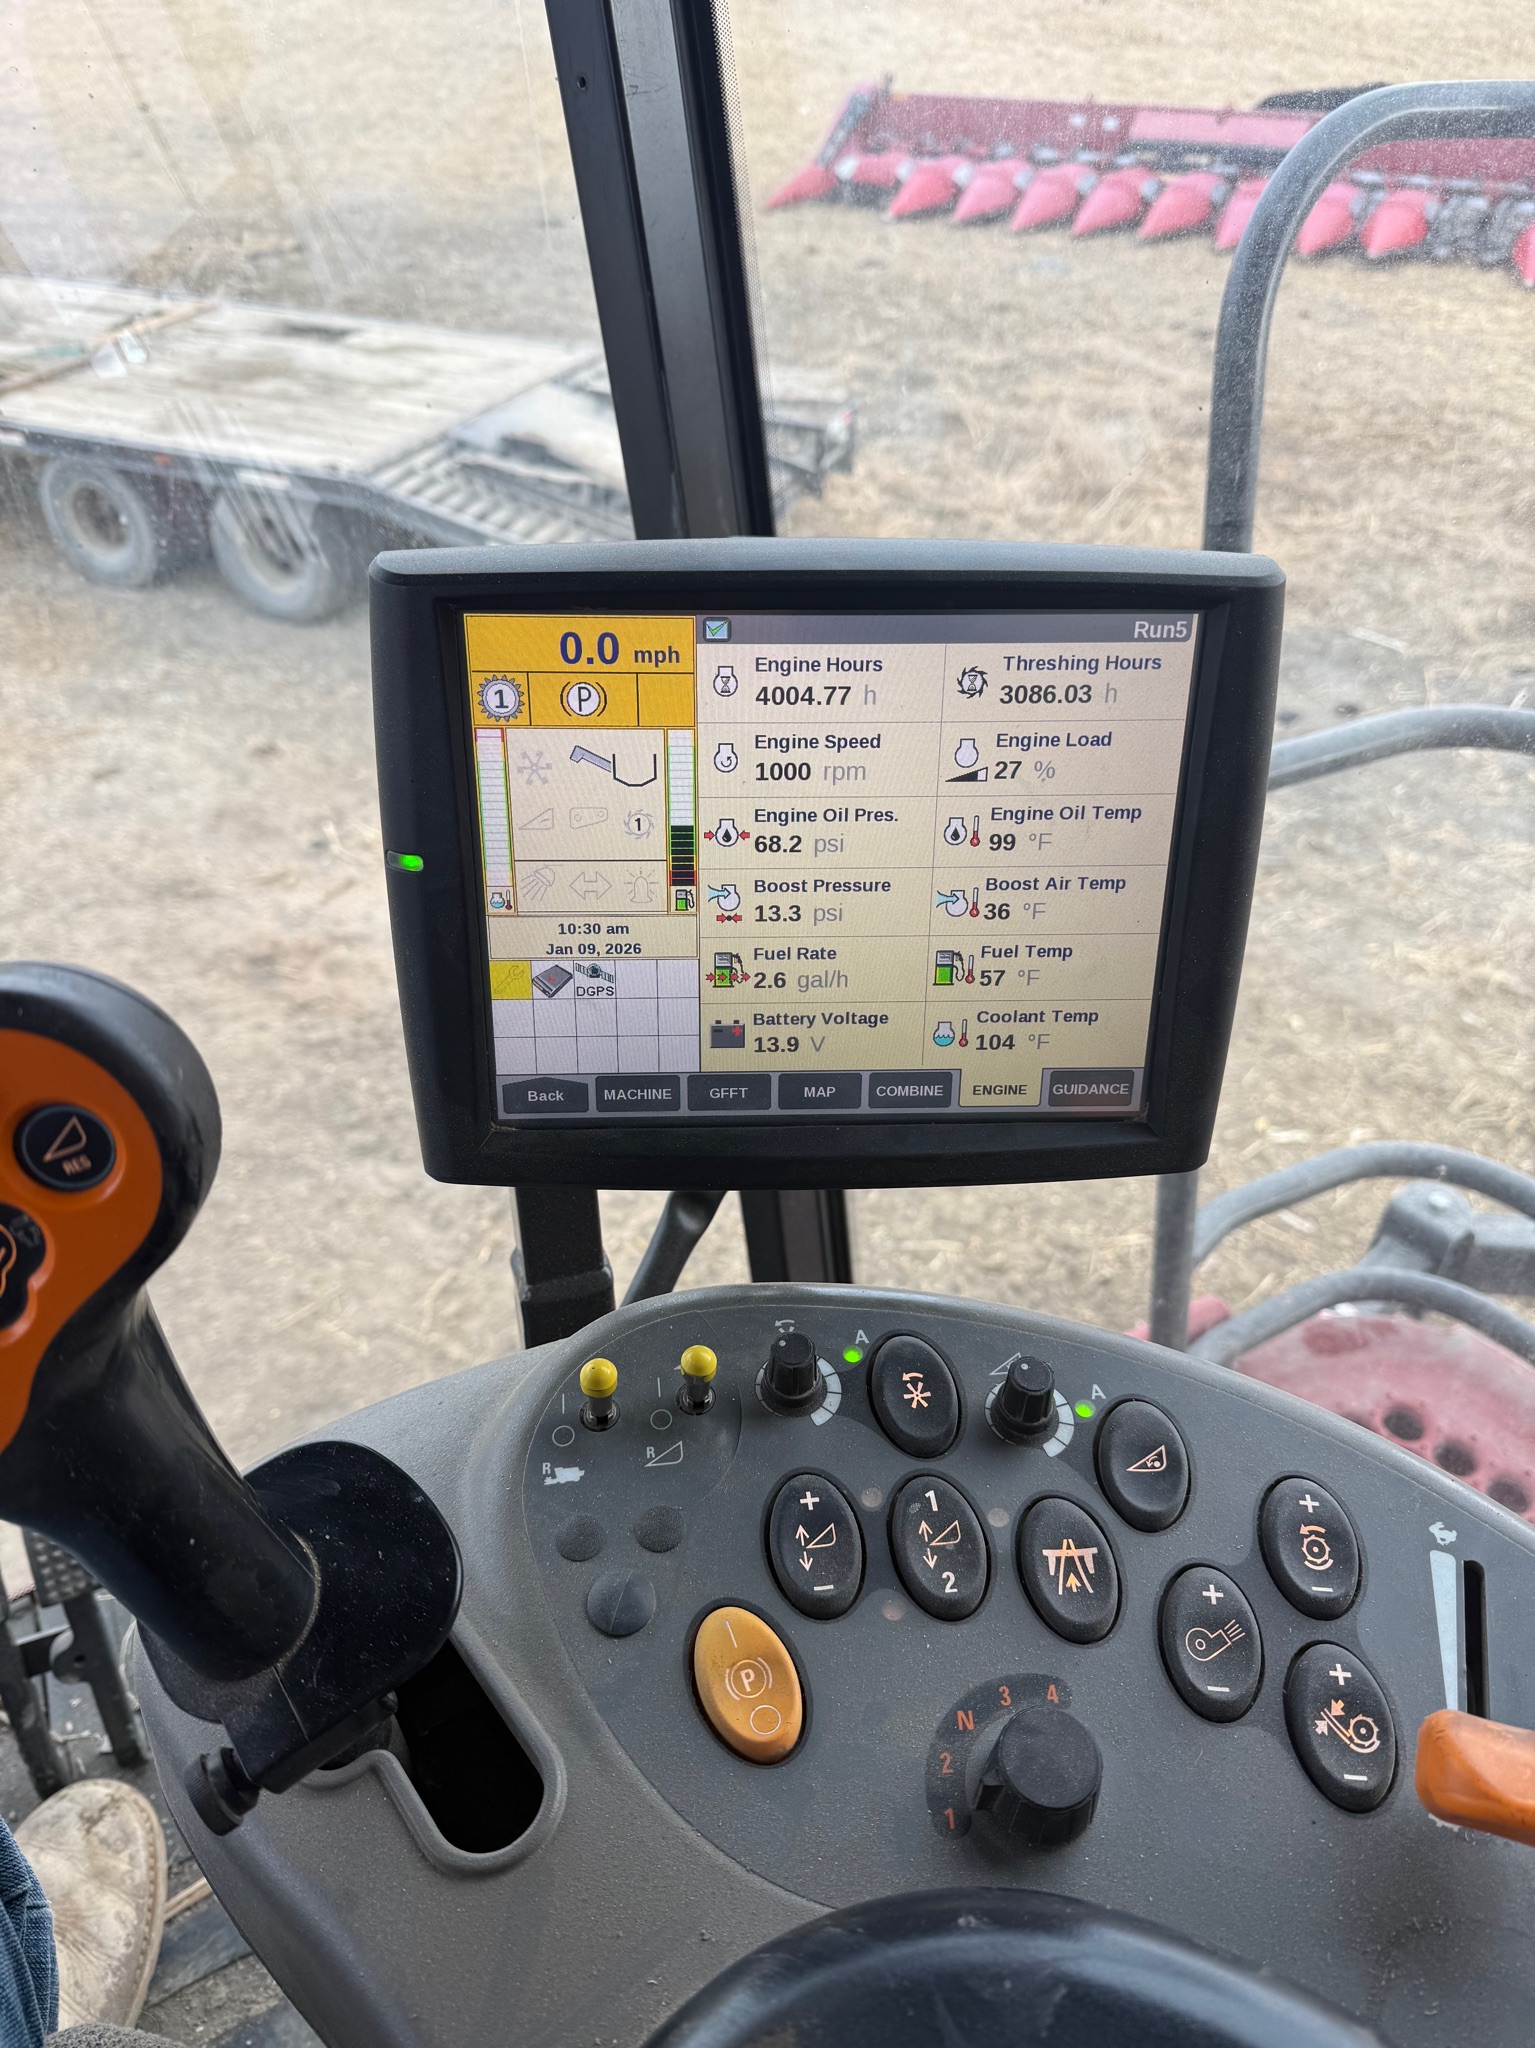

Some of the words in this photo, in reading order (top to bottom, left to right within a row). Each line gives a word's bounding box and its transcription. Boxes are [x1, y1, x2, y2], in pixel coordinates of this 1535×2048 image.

[1133, 620, 1188, 639] Run5
[560, 631, 620, 665] 0.0
[634, 646, 680, 668] mph
[755, 656, 821, 677] Engine
[826, 656, 883, 673] Hours
[1003, 654, 1100, 675] Threshing
[1105, 655, 1162, 671] Hours
[577, 686, 592, 713] P
[755, 686, 852, 706] 4004.77
[864, 684, 877, 706] h
[999, 684, 1093, 705] 3086.03
[1104, 682, 1118, 704] h
[754, 734, 819, 754] Engine
[824, 733, 882, 754] Speed
[996, 732, 1061, 752] Engine
[1066, 731, 1113, 748] Load
[755, 762, 812, 782] 1000
[823, 764, 867, 786] rpm
[994, 760, 1023, 780] 27
[1034, 760, 1056, 780] %
[754, 808, 818, 827] Engine
[823, 808, 849, 823] Oil
[854, 808, 899, 823] Pres.
[990, 806, 1054, 825] Engine
[1059, 805, 1086, 821] Oil
[1092, 806, 1142, 824] Temp
[754, 834, 802, 854] 68.2
[814, 833, 845, 858] psi
[988, 833, 1016, 852] 99
[1028, 832, 1053, 851] °F
[754, 879, 808, 894] Boost
[813, 879, 892, 894] Pressure
[985, 877, 1040, 892] Boost
[1044, 876, 1072, 891] Air
[1077, 876, 1127, 894] Temp
[754, 904, 802, 923] 13.3
[813, 903, 843, 927] psi
[983, 902, 1011, 921] 36
[1023, 902, 1047, 920] °F
[558, 922, 602, 936] 10:30
[606, 925, 630, 936] am
[546, 943, 574, 956] Jan
[577, 943, 601, 957] 09,
[605, 943, 642, 956] 2026
[754, 946, 792, 961] Fuel
[796, 947, 838, 961] Rate
[980, 945, 1019, 959] Fuel
[1025, 944, 1074, 962] Temp
[753, 972, 787, 989] 2.6
[797, 970, 849, 993] gal/h
[979, 969, 1006, 987] 57
[1018, 969, 1041, 987] °F
[576, 986, 615, 998] DGPS
[753, 1012, 817, 1029] Battery
[820, 1011, 890, 1028] Voltage
[976, 1010, 1046, 1024] Coolant
[1052, 1010, 1100, 1026] Temp
[754, 1036, 800, 1054] 13.9
[810, 1036, 826, 1052] V
[975, 1034, 1016, 1051] 104
[1028, 1034, 1051, 1050] °F
[528, 1090, 565, 1102] Back
[604, 1088, 672, 1101] MACHINE
[709, 1087, 749, 1100] GFFT
[804, 1086, 836, 1098] MAP
[876, 1085, 944, 1098] COMBINE
[972, 1084, 1028, 1096] ENGINE
[1052, 1083, 1130, 1096] GUIDANCE
[854, 1329, 870, 1345] A
[1090, 1383, 1107, 1400] A
[646, 1446, 656, 1459] R
[542, 1462, 552, 1476] R
[924, 1490, 939, 1512] 1
[941, 1571, 958, 1594] 2
[740, 1668, 756, 1692] P
[999, 1685, 1012, 1706] 3
[1046, 1684, 1060, 1704] 4
[956, 1710, 976, 1732] N
[940, 1752, 954, 1775] 2
[944, 1808, 956, 1830] 1
